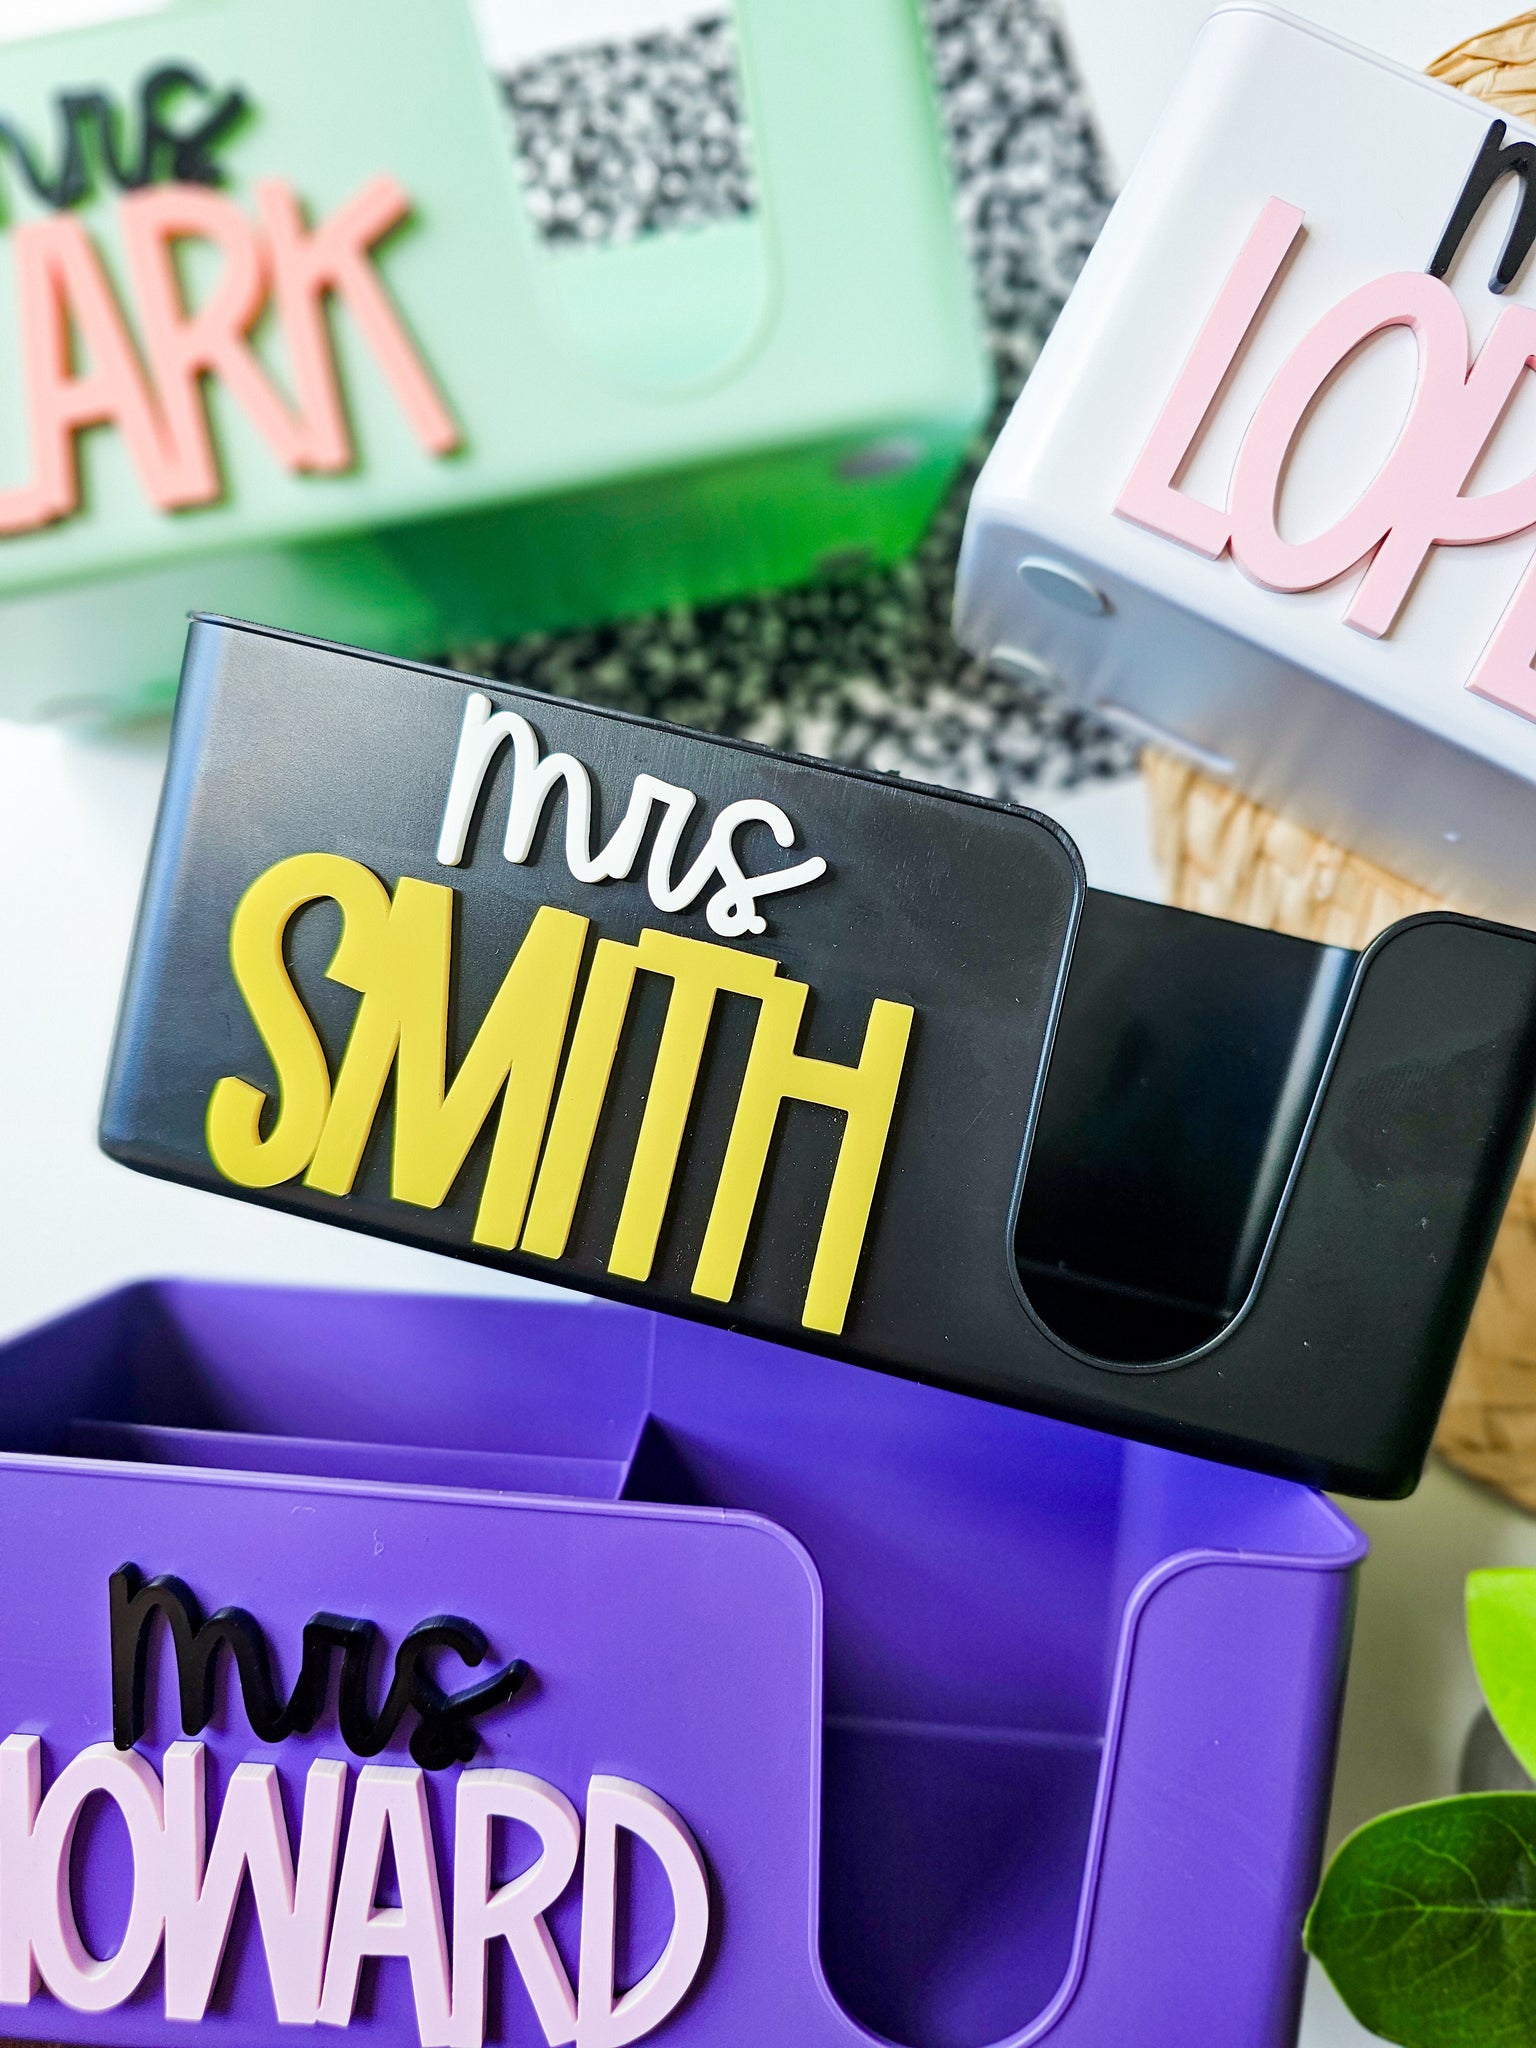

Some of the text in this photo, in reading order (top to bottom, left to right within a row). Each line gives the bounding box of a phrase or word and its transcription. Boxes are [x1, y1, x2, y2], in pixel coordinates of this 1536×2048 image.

[0, 58, 252, 206] rs
[436, 693, 828, 937] mrs
[205, 852, 915, 1335] SMITH
[109, 1561, 530, 1770] mrs
